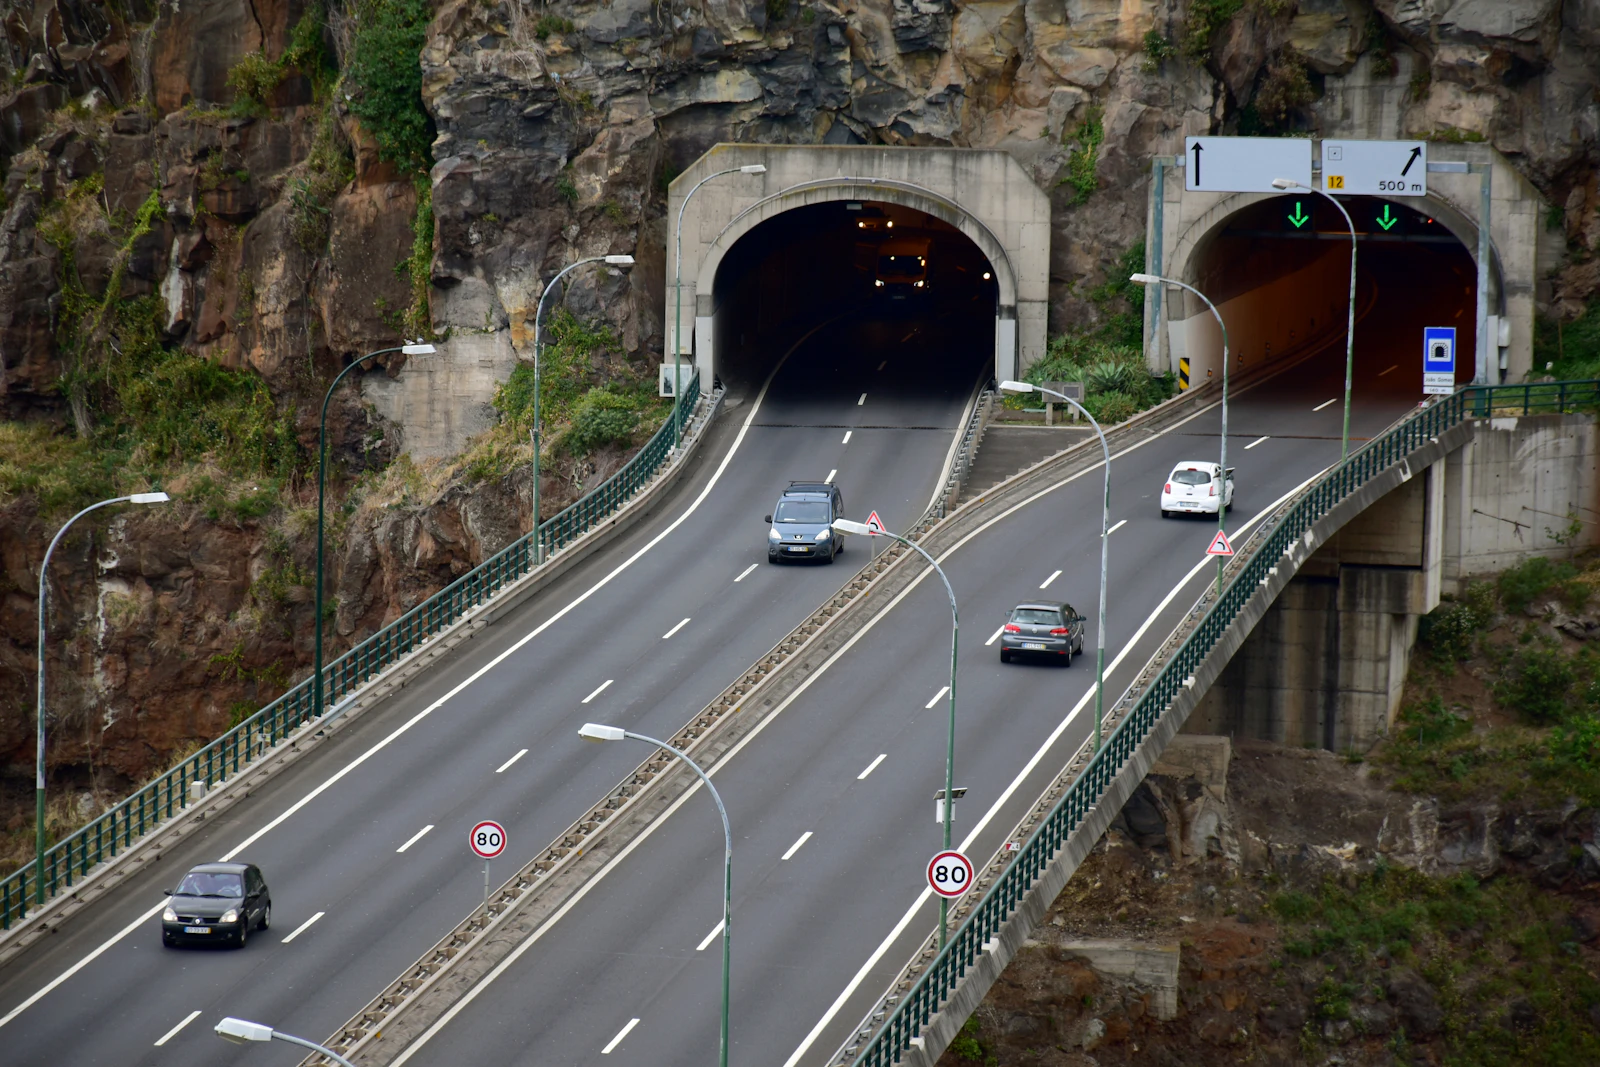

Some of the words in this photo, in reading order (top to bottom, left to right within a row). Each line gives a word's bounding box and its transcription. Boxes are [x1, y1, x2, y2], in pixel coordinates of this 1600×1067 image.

[1330, 176, 1342, 188] 12
[1379, 181, 1405, 191] 500
[477, 832, 500, 846] 80
[935, 865, 965, 884] 80
